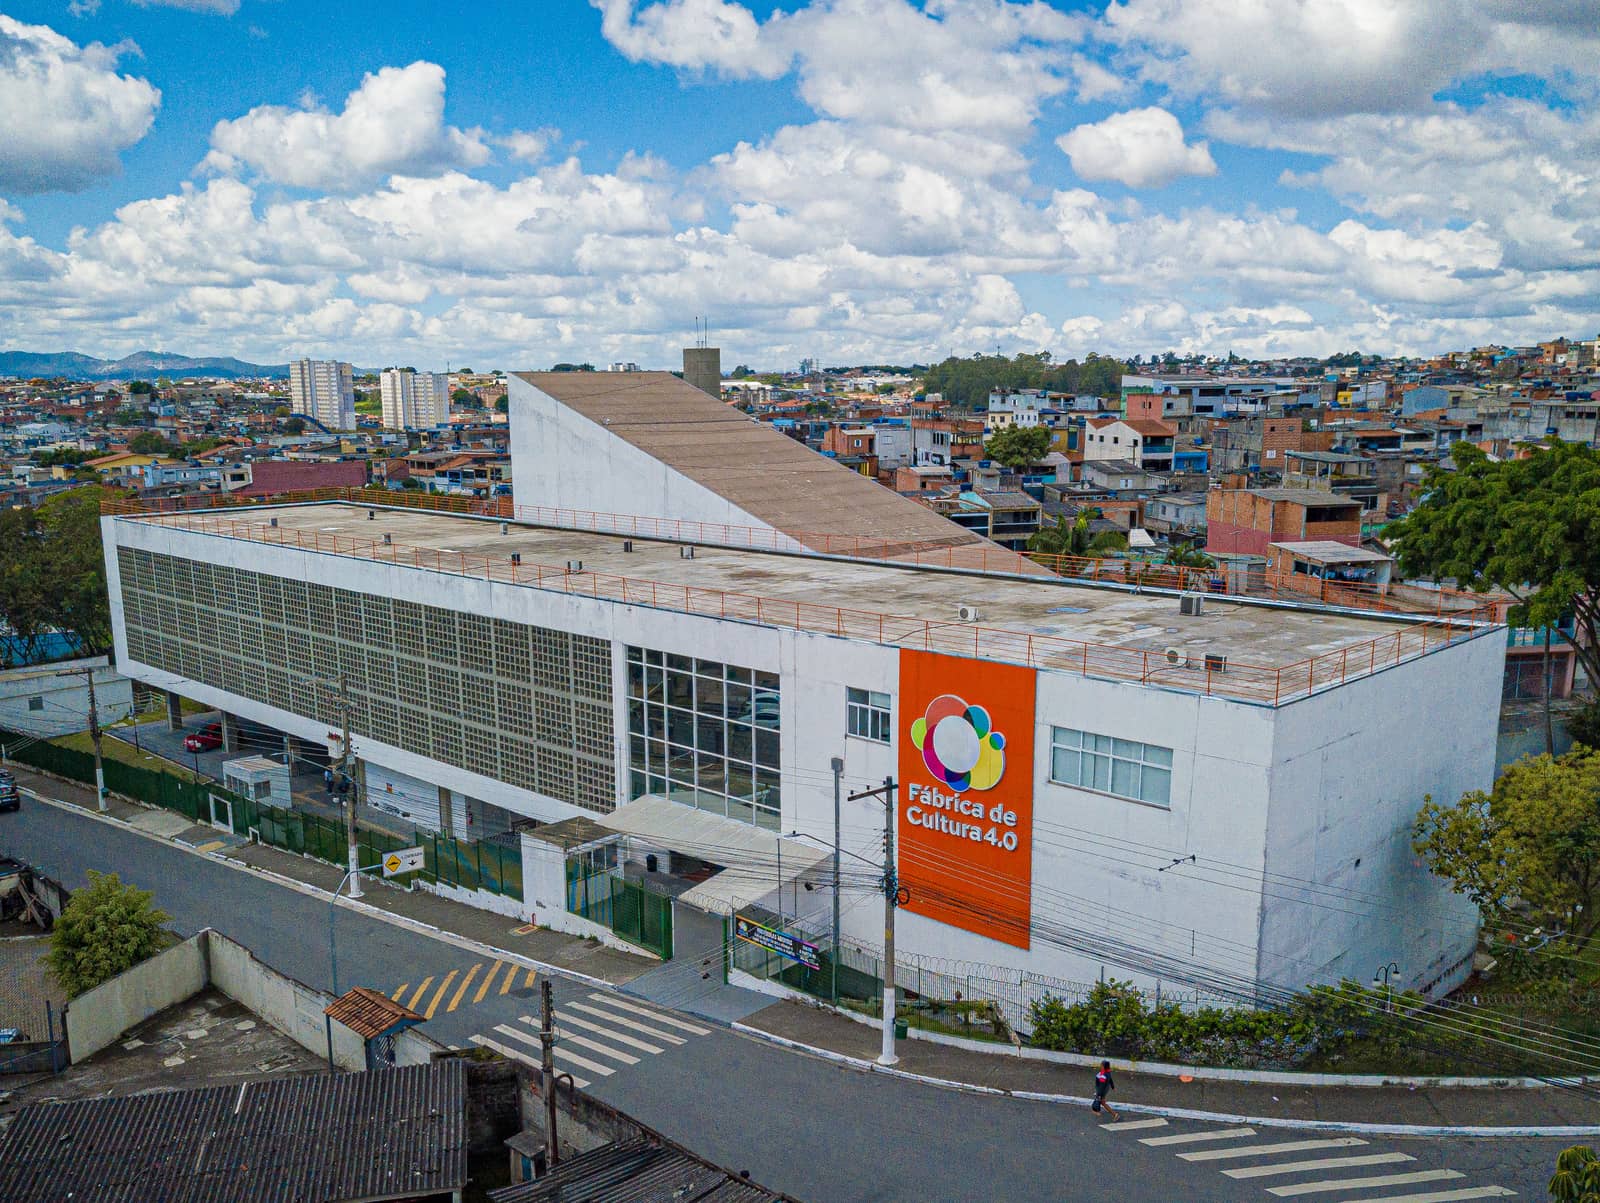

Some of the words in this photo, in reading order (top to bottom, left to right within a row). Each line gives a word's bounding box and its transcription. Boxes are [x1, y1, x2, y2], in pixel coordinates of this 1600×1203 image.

[908, 783, 985, 818] Fábrica
[989, 803, 1017, 827] de
[907, 806, 982, 842] Cultura
[983, 827, 1017, 851] 4.0
